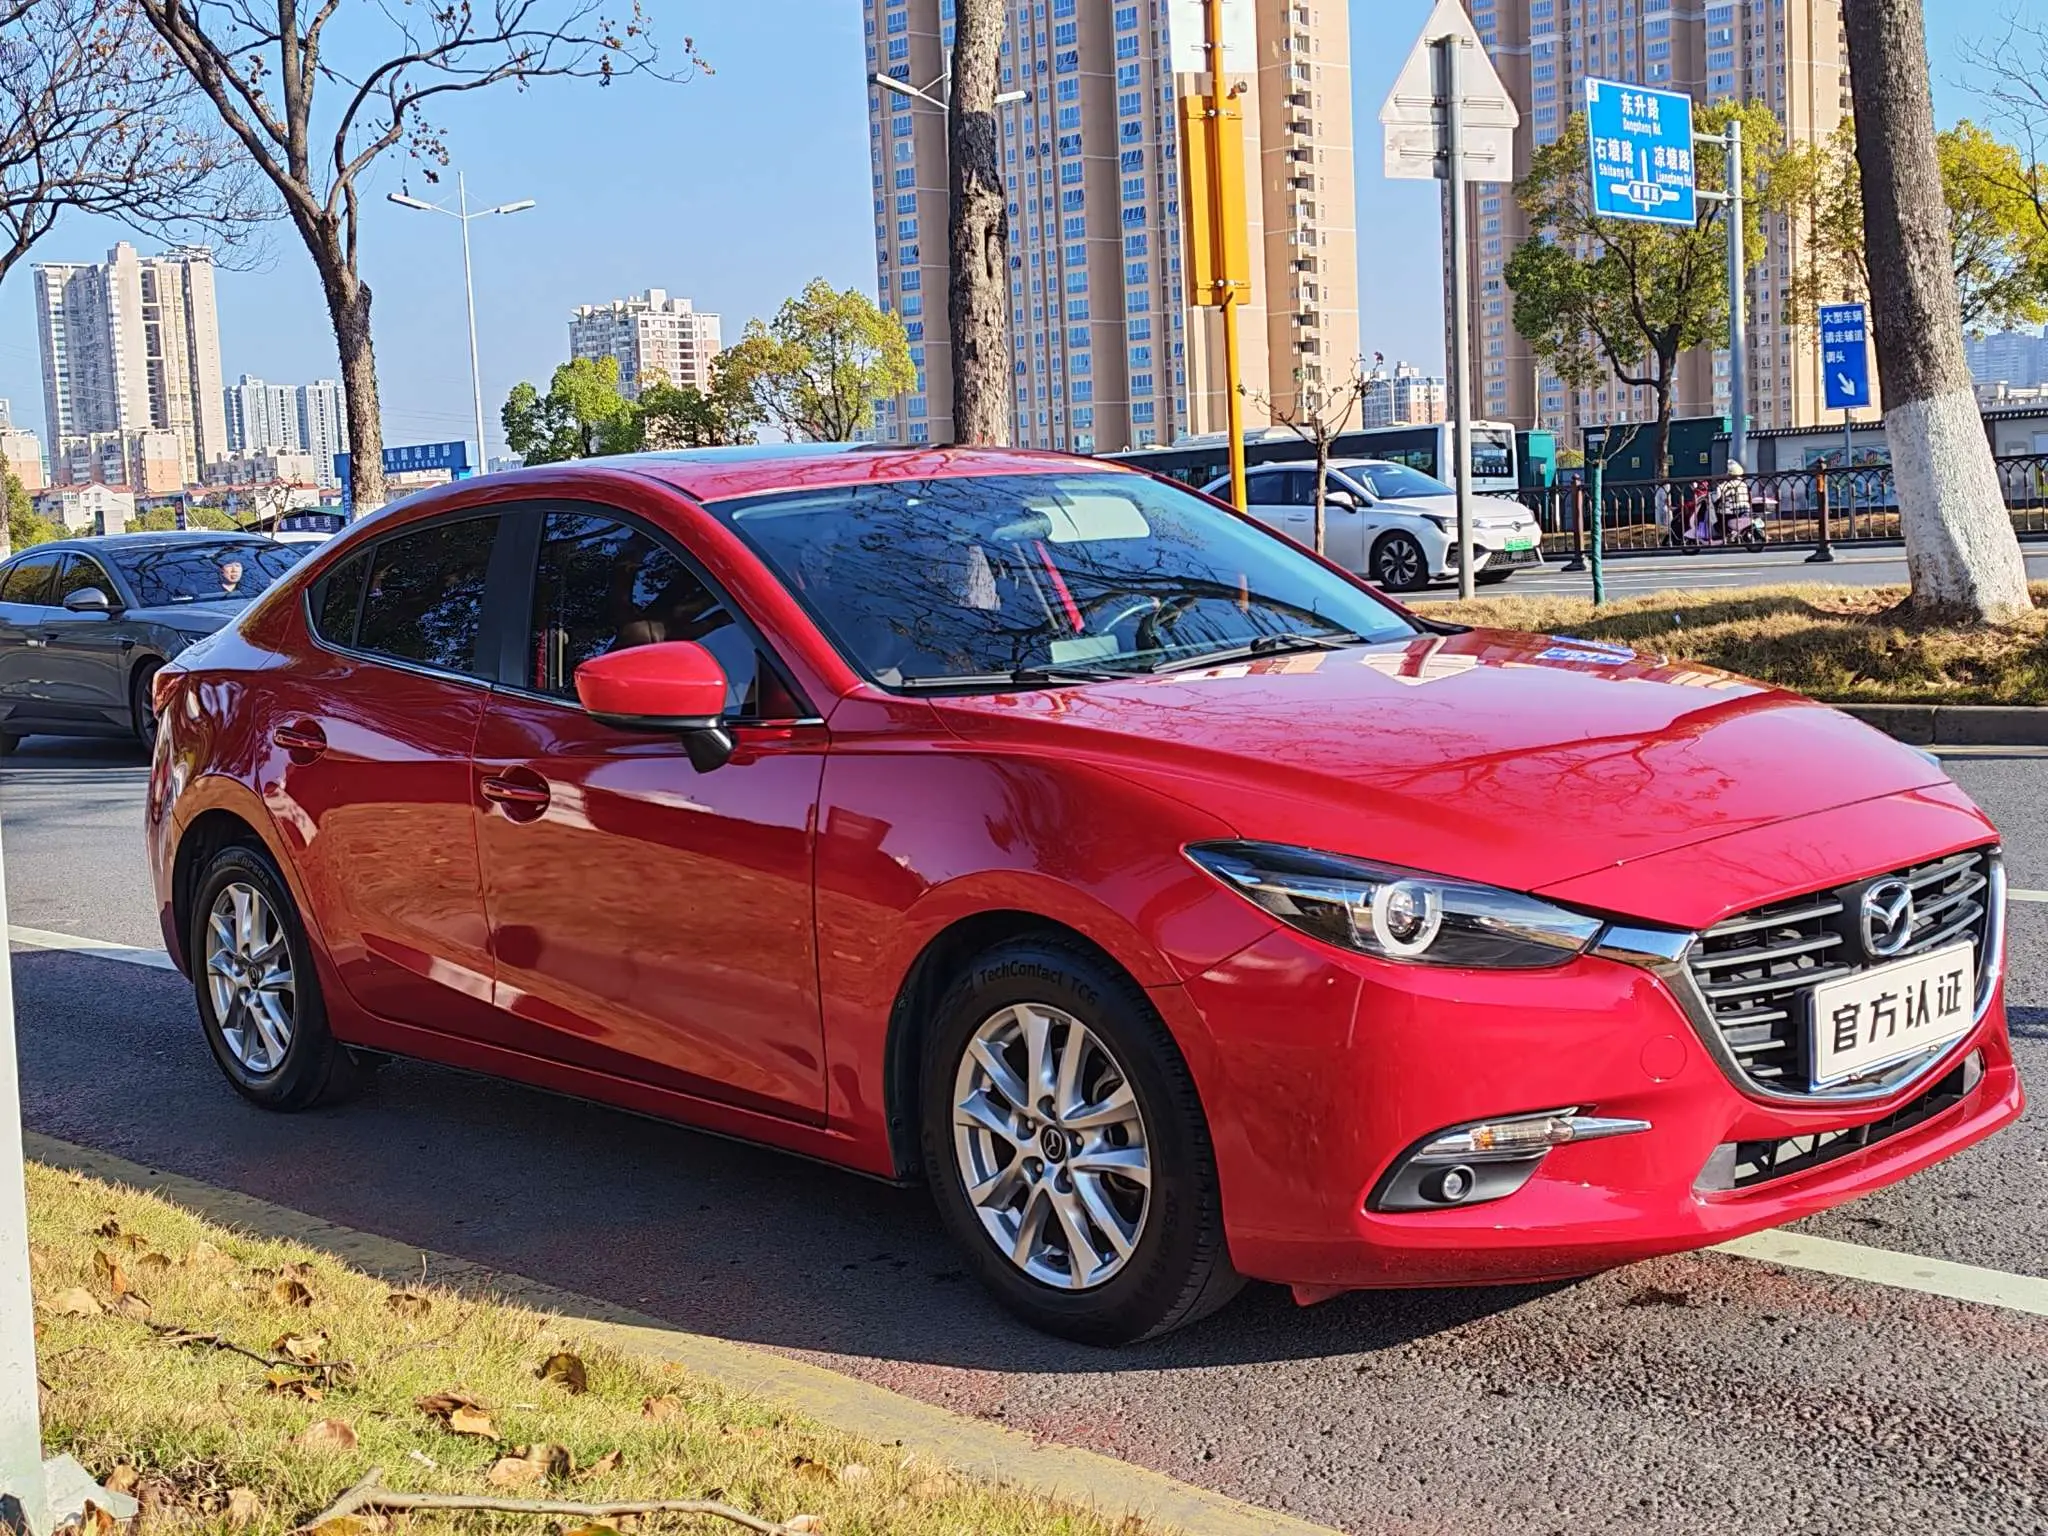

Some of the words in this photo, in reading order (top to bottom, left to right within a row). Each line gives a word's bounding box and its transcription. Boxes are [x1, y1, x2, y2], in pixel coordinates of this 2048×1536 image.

[1620, 91, 1660, 120] 东升路
[1595, 137, 1634, 164] 石塘路
[1654, 145, 1690, 172] 凉塘路
[1823, 310, 1863, 325] 大型车辆
[979, 960, 1064, 988] TechContact
[1071, 976, 1100, 1006] TC6
[1832, 969, 1964, 1055] 官方认证
